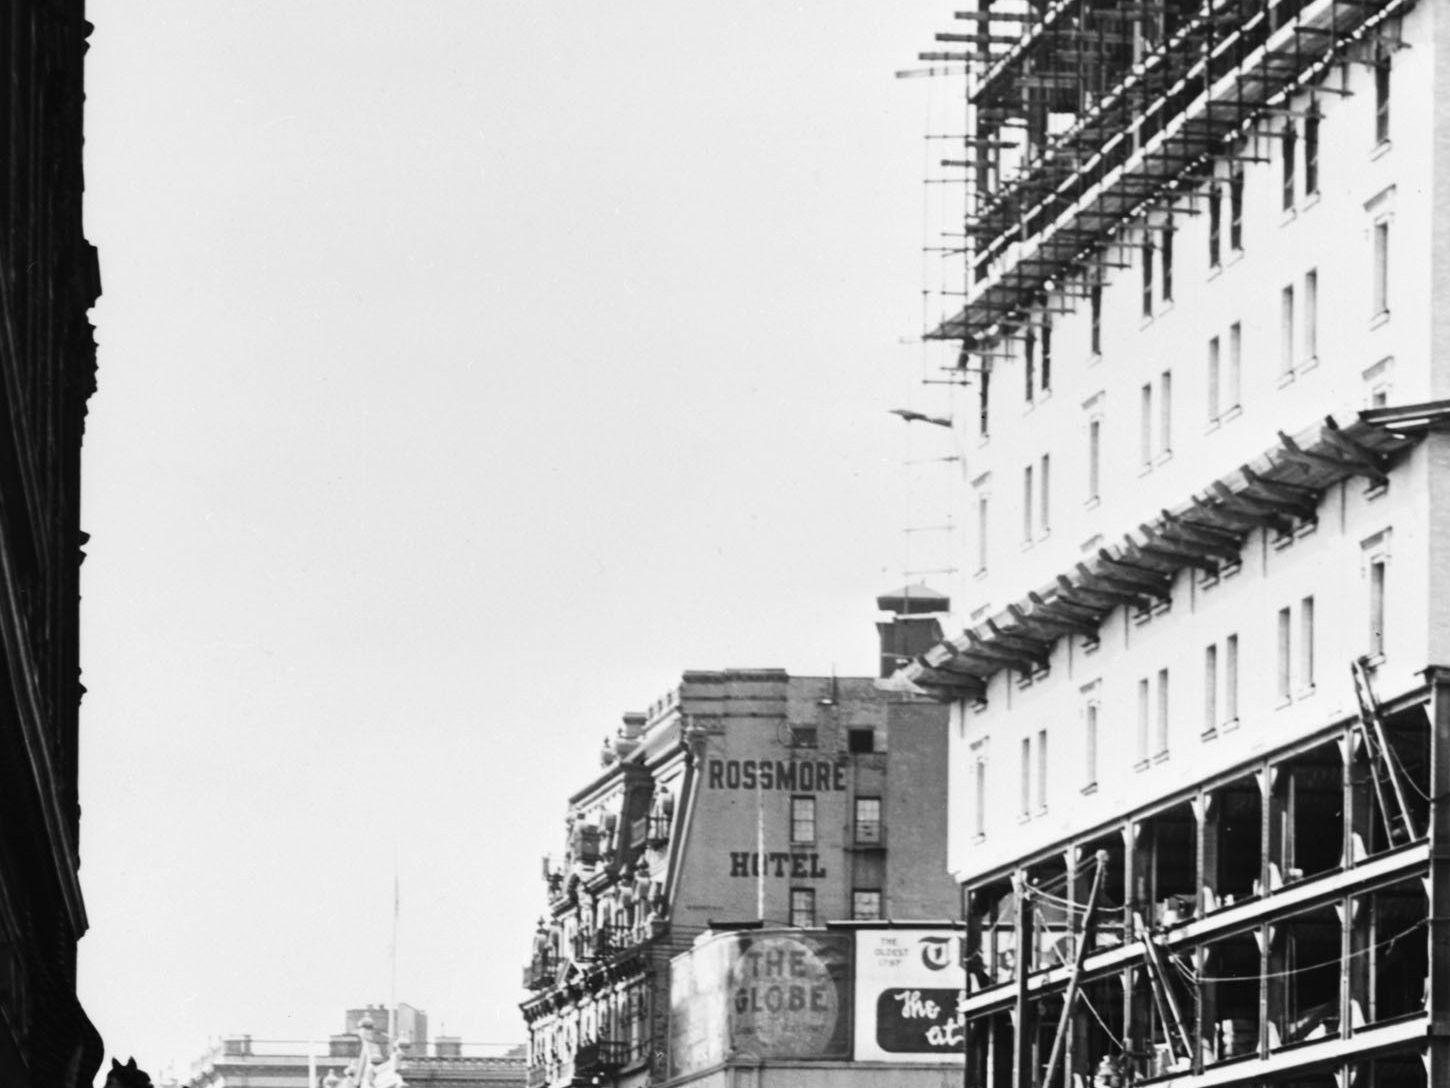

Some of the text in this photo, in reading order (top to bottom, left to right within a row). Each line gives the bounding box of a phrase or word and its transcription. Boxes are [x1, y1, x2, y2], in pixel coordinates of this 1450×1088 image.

[709, 759, 846, 791] ROSSMORE
[729, 852, 826, 878] HOTEL
[746, 949, 808, 978] THE
[734, 980, 829, 1015] GLOBE
[894, 990, 941, 1020] The
